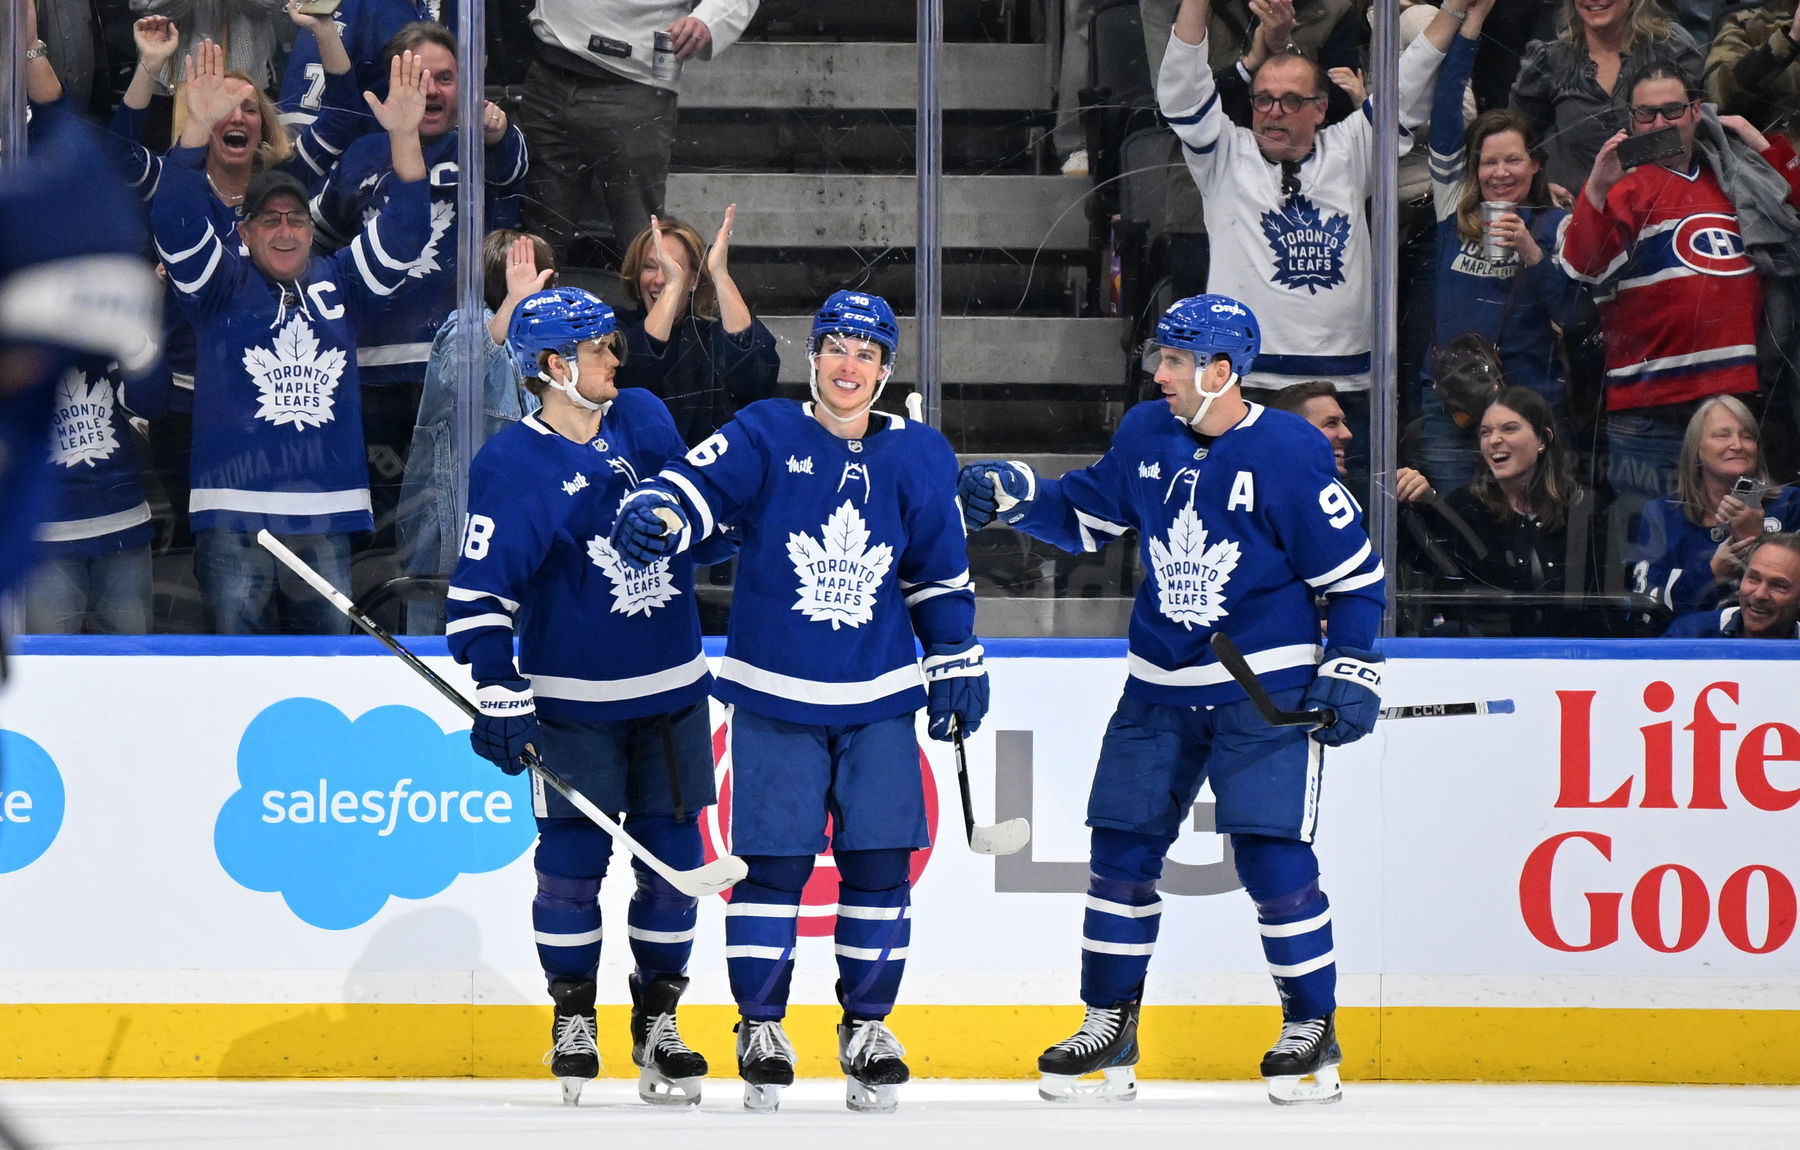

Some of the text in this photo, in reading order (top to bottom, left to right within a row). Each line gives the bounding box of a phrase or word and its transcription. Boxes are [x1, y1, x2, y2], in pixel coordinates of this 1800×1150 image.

[1277, 228, 1339, 250] TORONTO
[1289, 246, 1332, 259] MAPLE
[1289, 258, 1332, 272] LEAFS
[1460, 256, 1493, 275] MAPLE
[307, 279, 345, 320] C
[263, 364, 330, 386] TORONTO
[274, 382, 320, 395] MAPLE
[274, 395, 320, 408] LEAFS
[52, 403, 106, 426] ORONTO
[56, 417, 102, 439] MAPLE
[60, 430, 104, 451] LEAFS
[1227, 470, 1254, 512] A
[458, 512, 496, 561] 8
[624, 562, 660, 582] MAPLE
[806, 558, 875, 584] TORONTO
[1159, 560, 1219, 582] TORONTO
[626, 576, 661, 596] LEAFS
[817, 576, 864, 593] MAPLE
[1168, 579, 1208, 592] MAPLE
[814, 589, 862, 606] LEAFS
[1168, 592, 1208, 606] LEAFS
[480, 698, 534, 710] SHERW
[1411, 704, 1446, 717] CCM
[1553, 680, 1800, 812] Life
[261, 778, 513, 837] salesforce
